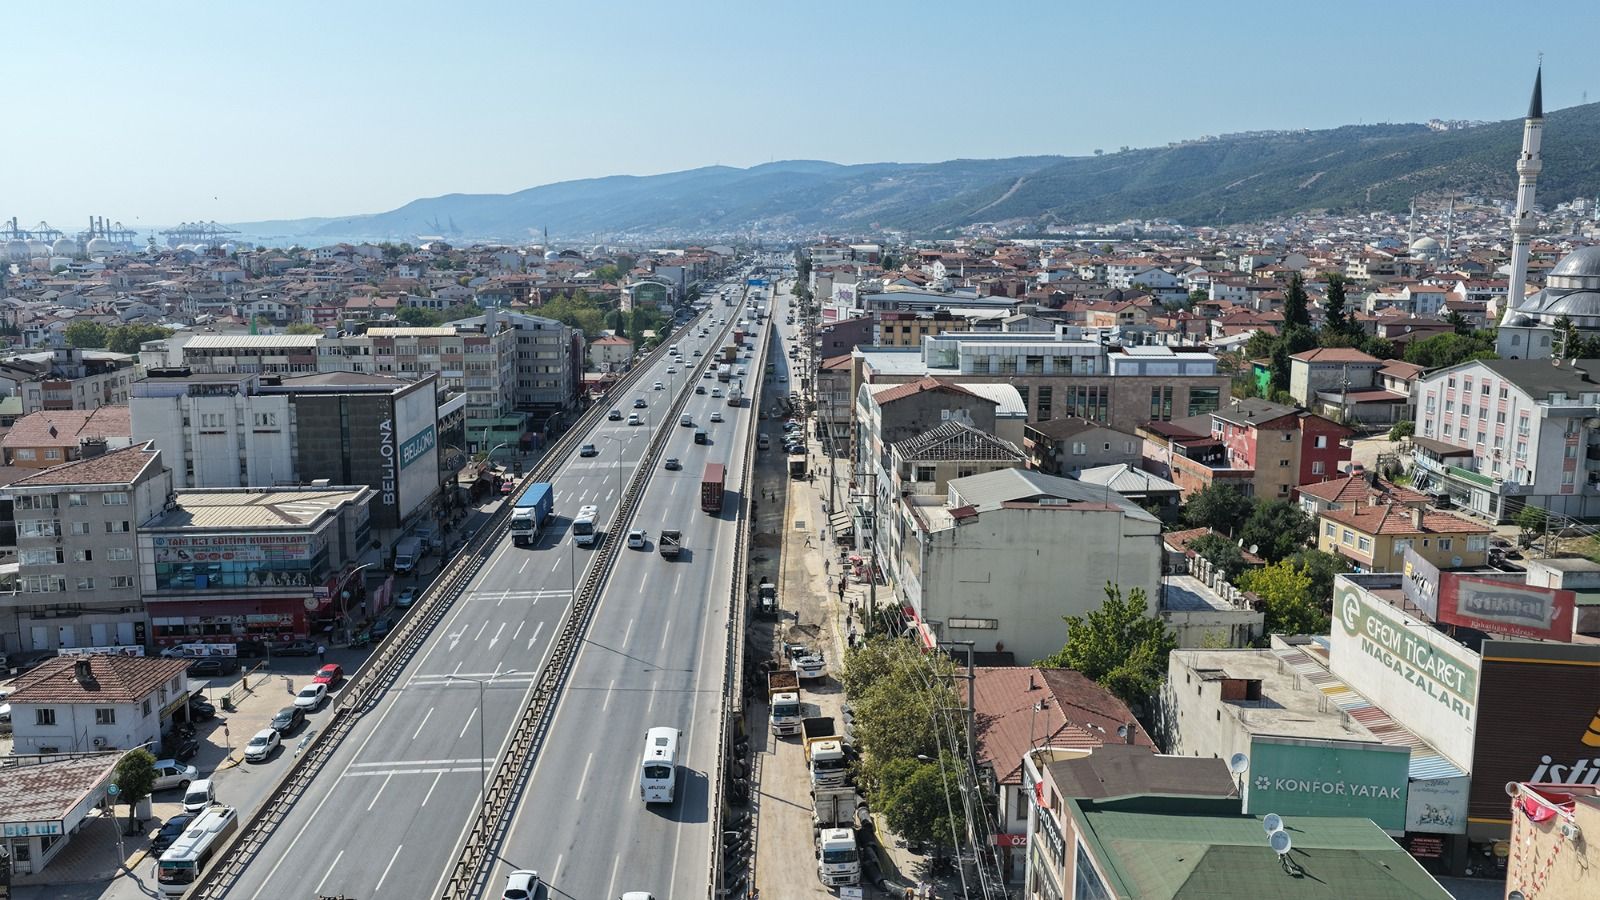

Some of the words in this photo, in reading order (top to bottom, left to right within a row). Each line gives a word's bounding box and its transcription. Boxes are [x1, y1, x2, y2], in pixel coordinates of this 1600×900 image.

[380, 419, 395, 506] BELLONA
[403, 431, 434, 463] BELLONA
[250, 534, 306, 545] KURUMLARI
[1366, 615, 1401, 654] EFEM
[1404, 636, 1466, 693] TİCARET
[1529, 754, 1600, 784] isti
[1275, 778, 1345, 795] KONFOR
[1350, 785, 1400, 799] YATAK
